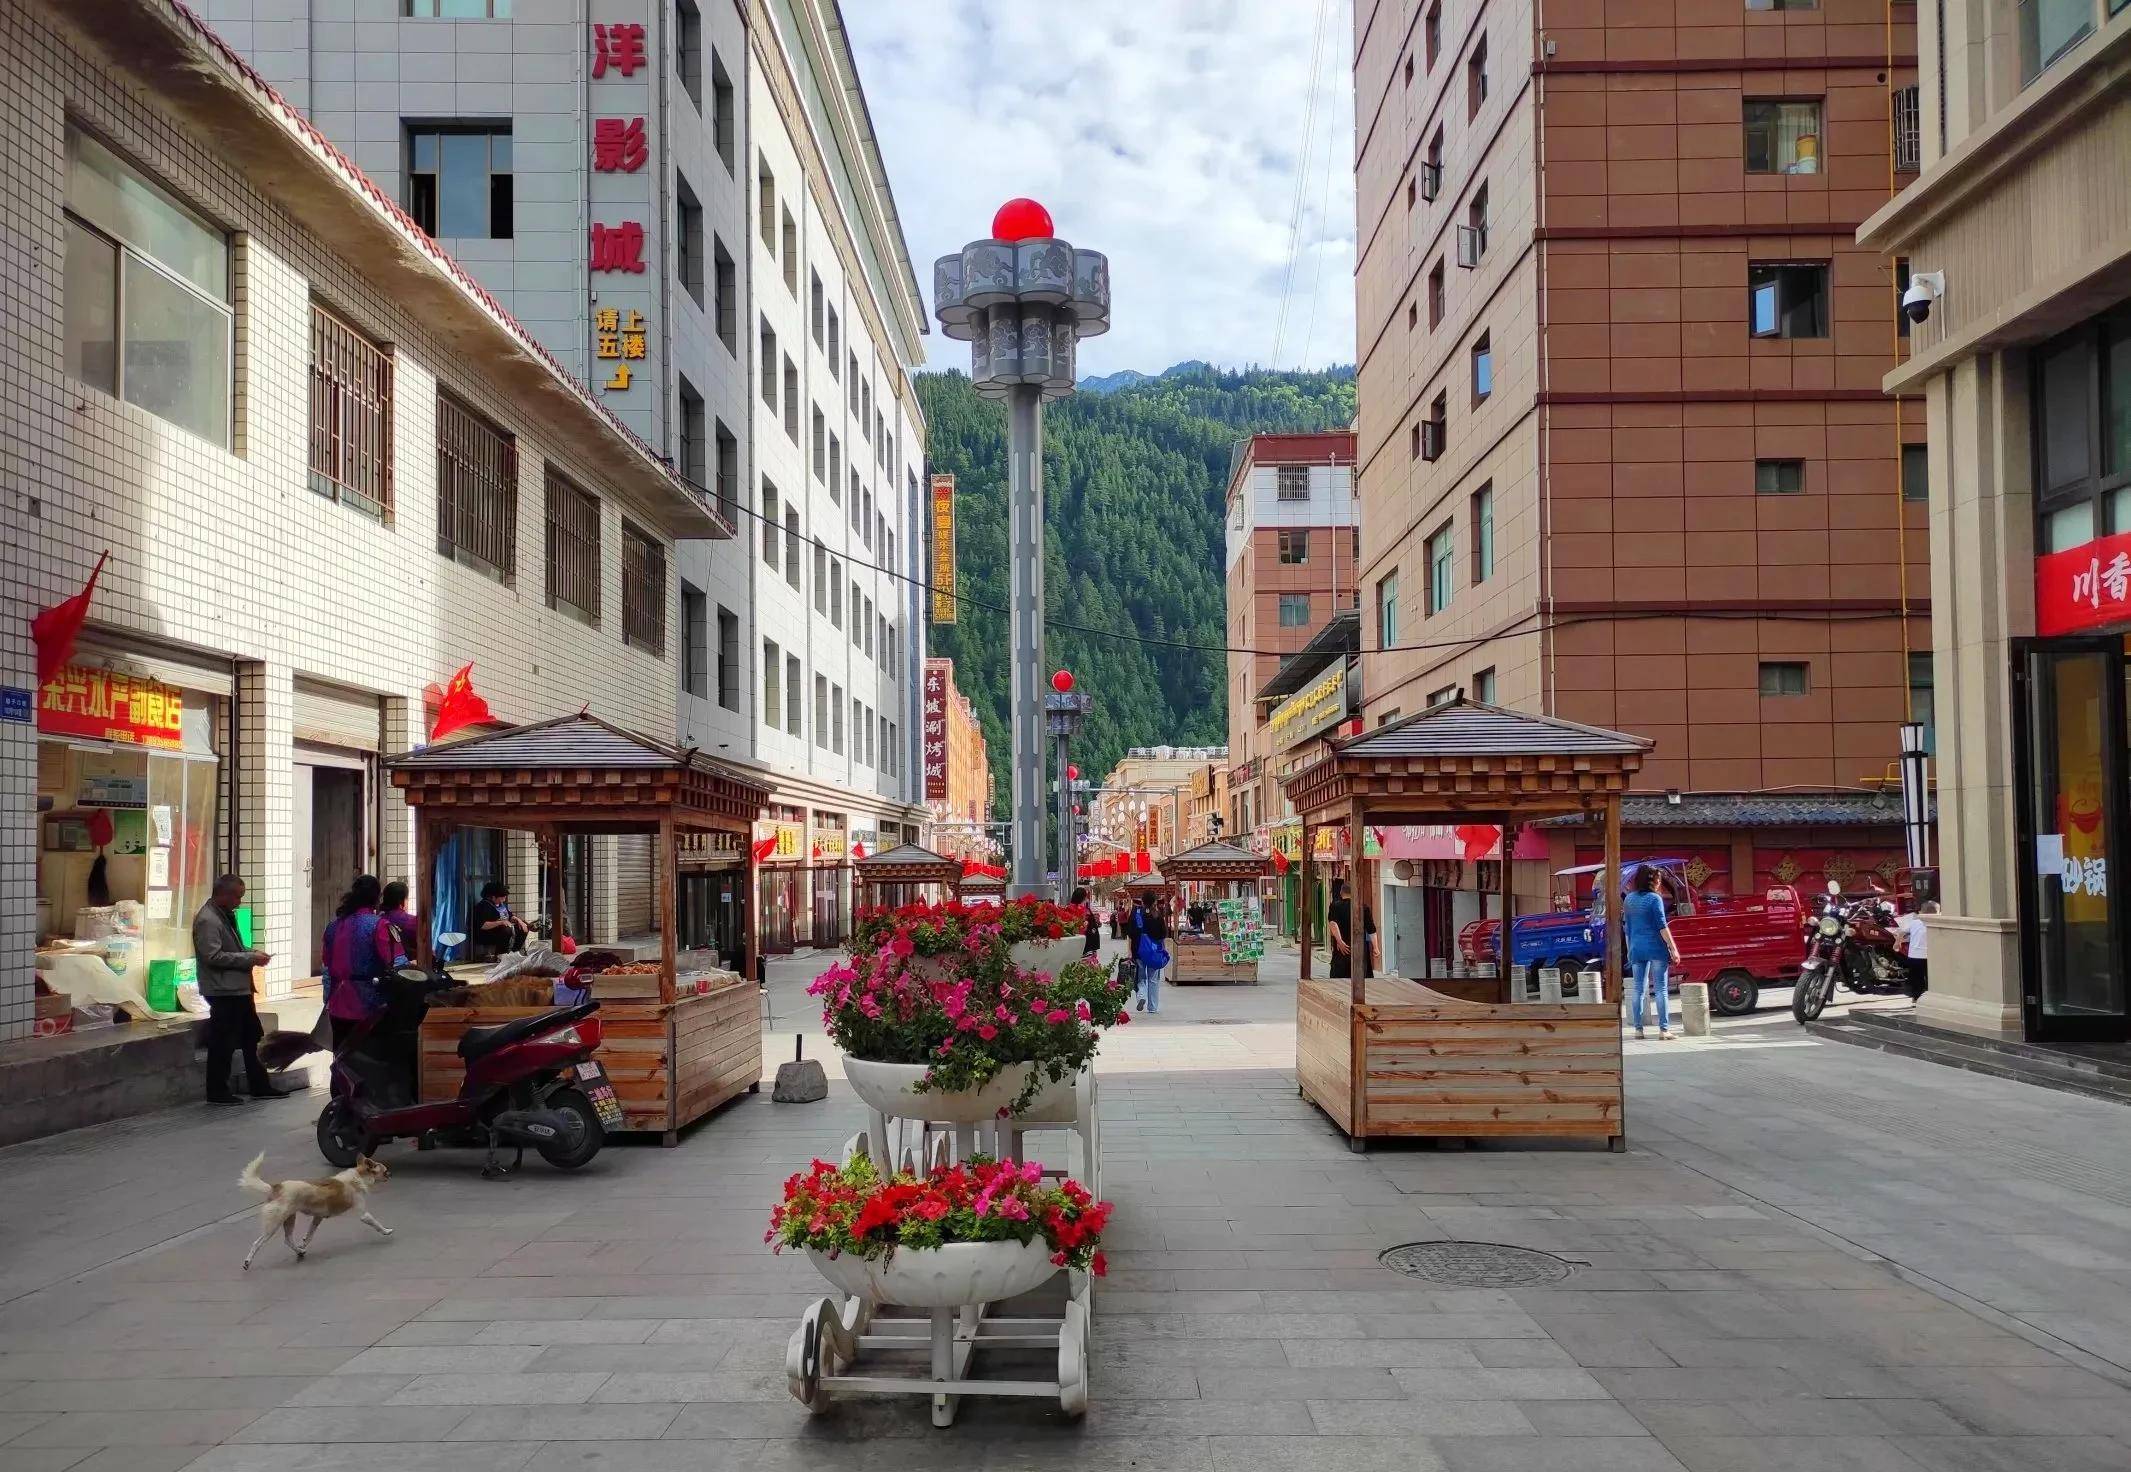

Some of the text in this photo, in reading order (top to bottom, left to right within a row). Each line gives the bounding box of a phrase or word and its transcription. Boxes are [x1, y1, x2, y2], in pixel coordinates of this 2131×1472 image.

[591, 22, 648, 274] 洋影城
[596, 309, 646, 333] 请上
[596, 334, 646, 359] 五楼
[2072, 551, 2131, 609] 川香
[925, 676, 943, 779] 东坡涮烤城
